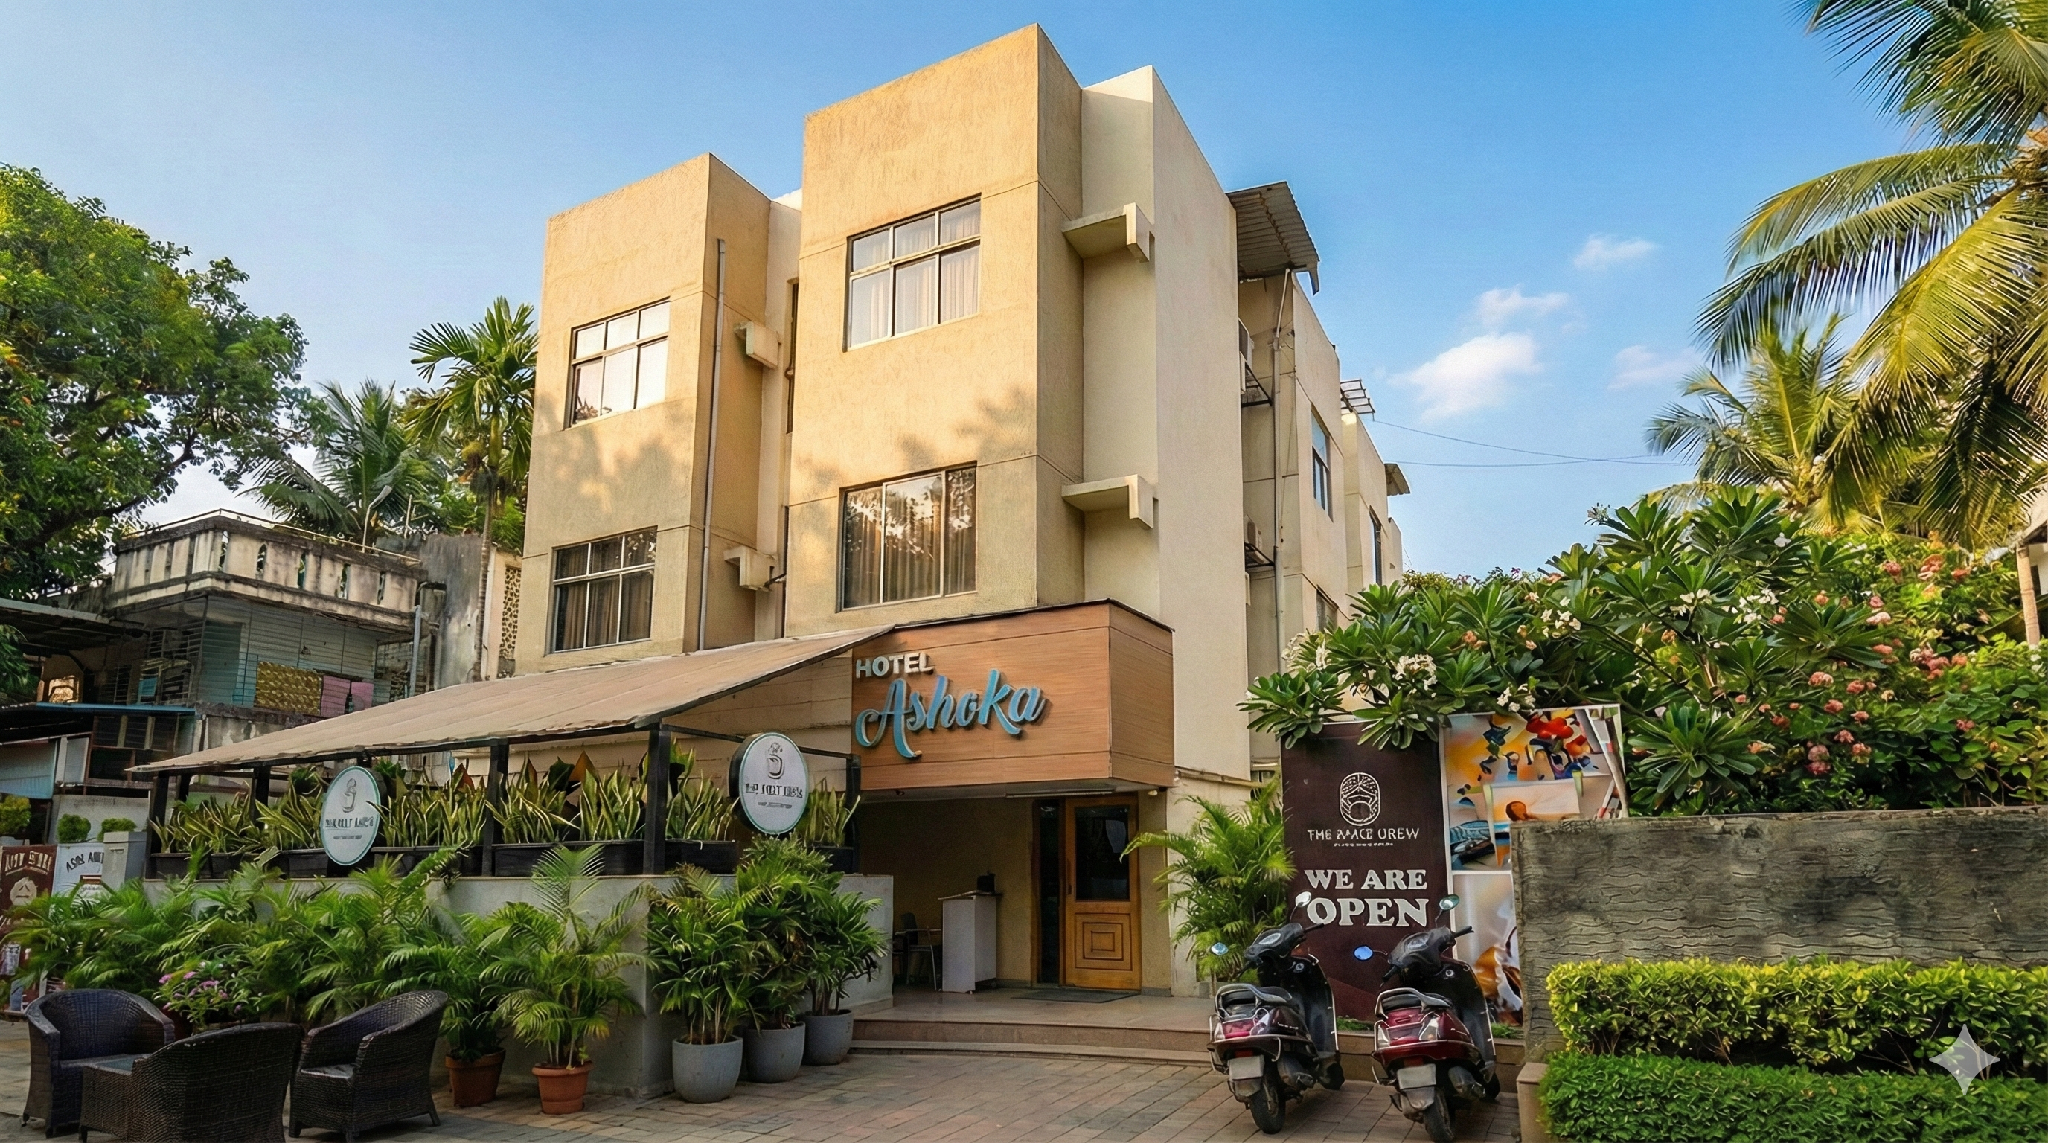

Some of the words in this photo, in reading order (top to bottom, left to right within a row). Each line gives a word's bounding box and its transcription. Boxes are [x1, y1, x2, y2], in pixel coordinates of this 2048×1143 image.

[855, 652, 934, 679] HOTEL
[855, 668, 1048, 759] Ashoka
[1304, 869, 1354, 890] WE
[1360, 869, 1428, 890] ARE
[1306, 897, 1430, 927] OPEN
